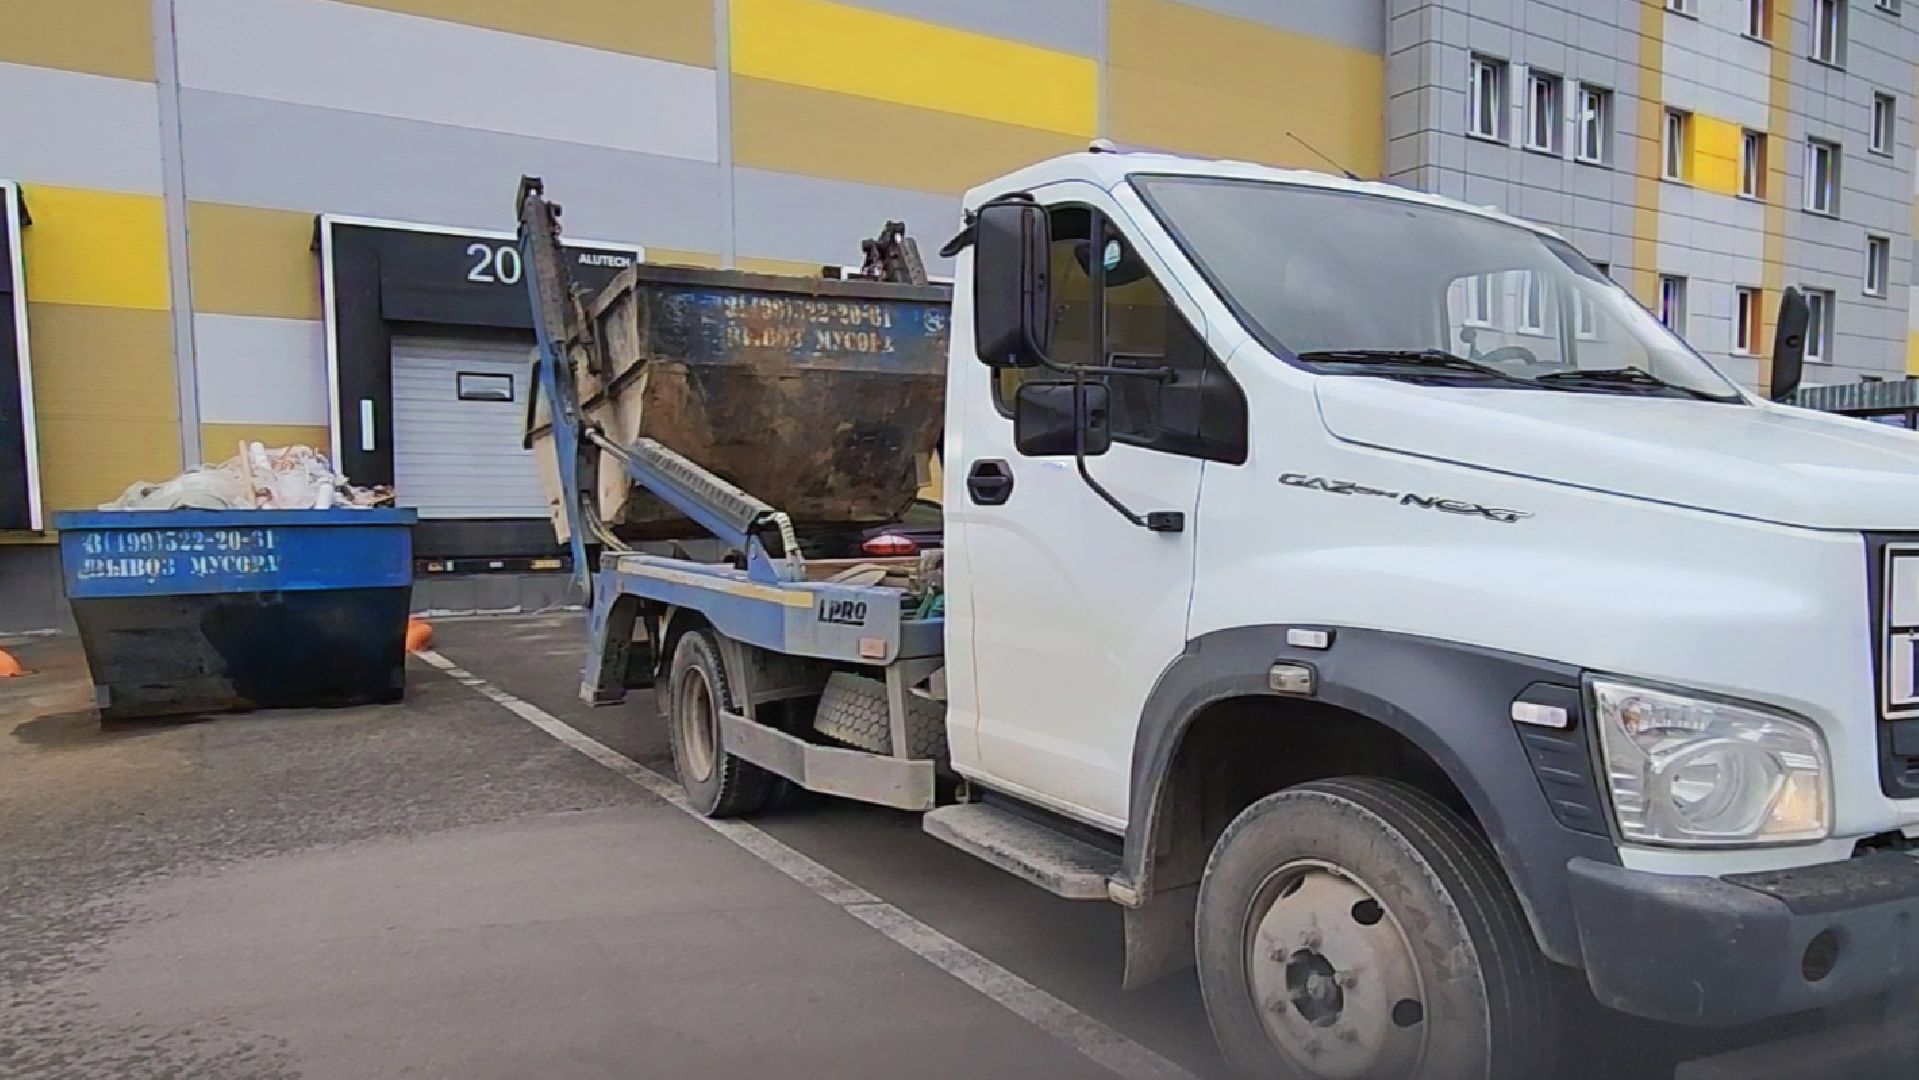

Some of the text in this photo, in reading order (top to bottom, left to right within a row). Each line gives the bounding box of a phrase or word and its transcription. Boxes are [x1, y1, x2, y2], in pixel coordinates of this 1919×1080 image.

[467, 243, 521, 284] 20
[578, 253, 631, 268] ALUTECH
[190, 555, 279, 576] МУСОРА
